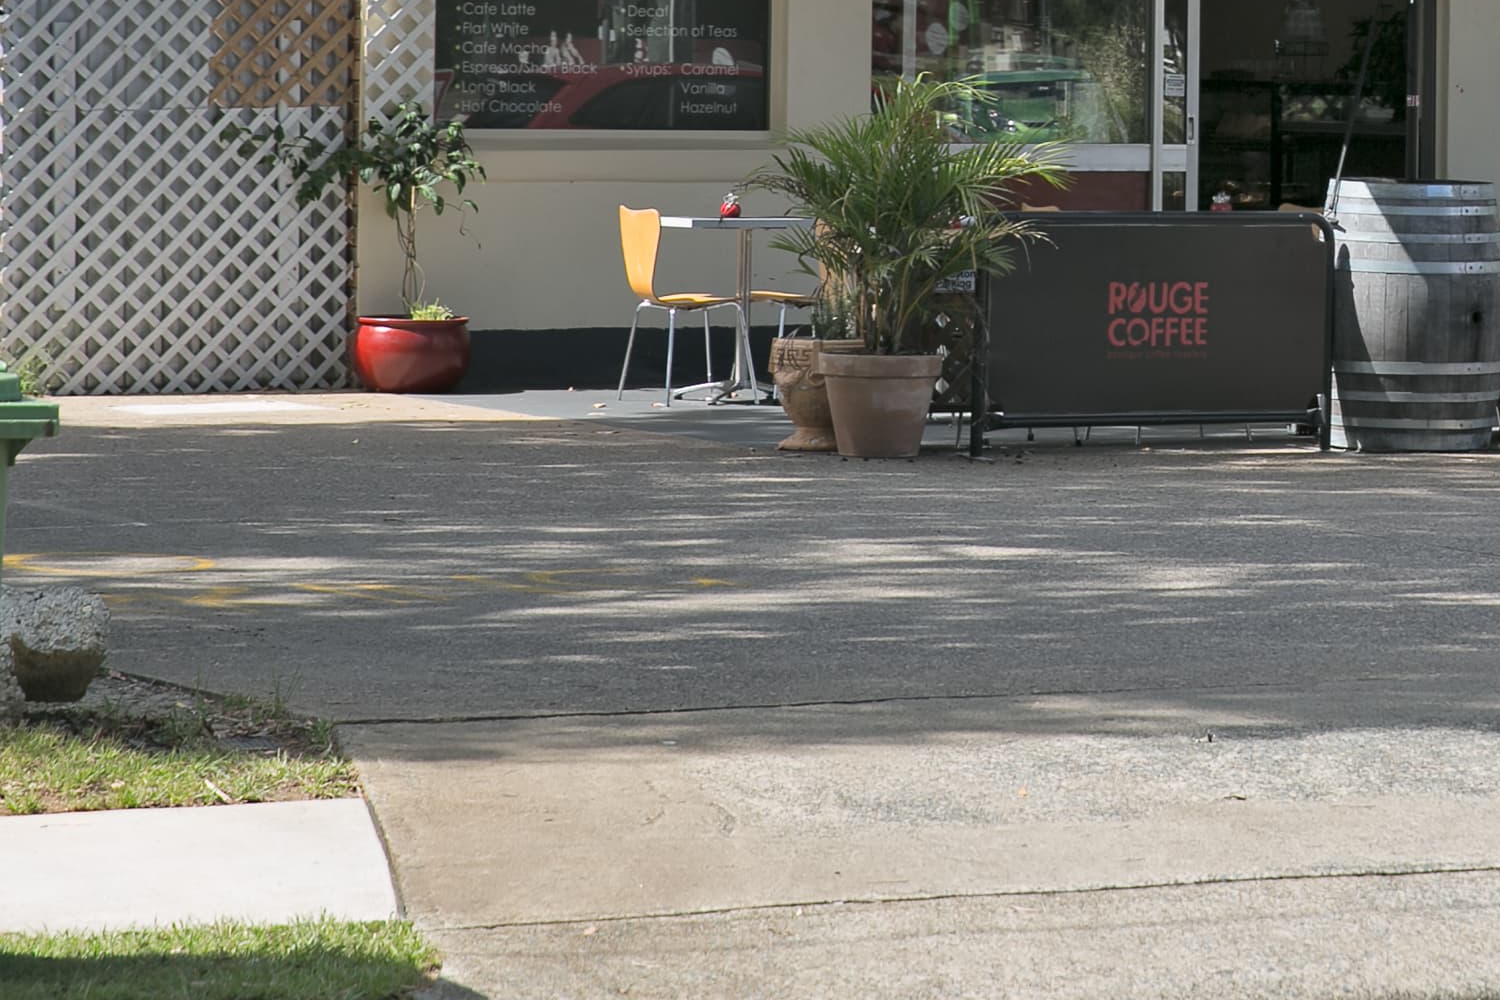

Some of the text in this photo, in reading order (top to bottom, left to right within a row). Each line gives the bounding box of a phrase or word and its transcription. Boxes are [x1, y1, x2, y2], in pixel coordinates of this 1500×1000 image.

[463, 2, 536, 15] Cafe Latte
[627, 5, 669, 17] Decaf
[463, 22, 529, 35] Flat White
[627, 24, 737, 38] Selection of Teas
[462, 42, 550, 54] Cafe Mocha
[561, 62, 598, 74] Black
[626, 62, 740, 77] Syrups: Caramel
[461, 81, 536, 96] Long Black
[680, 82, 726, 95] Vanilla
[461, 100, 562, 113] Hot Chocolate
[680, 101, 737, 114] Hazelnut
[1107, 281, 1209, 315] ROUGE
[1107, 317, 1208, 347] COFFEE
